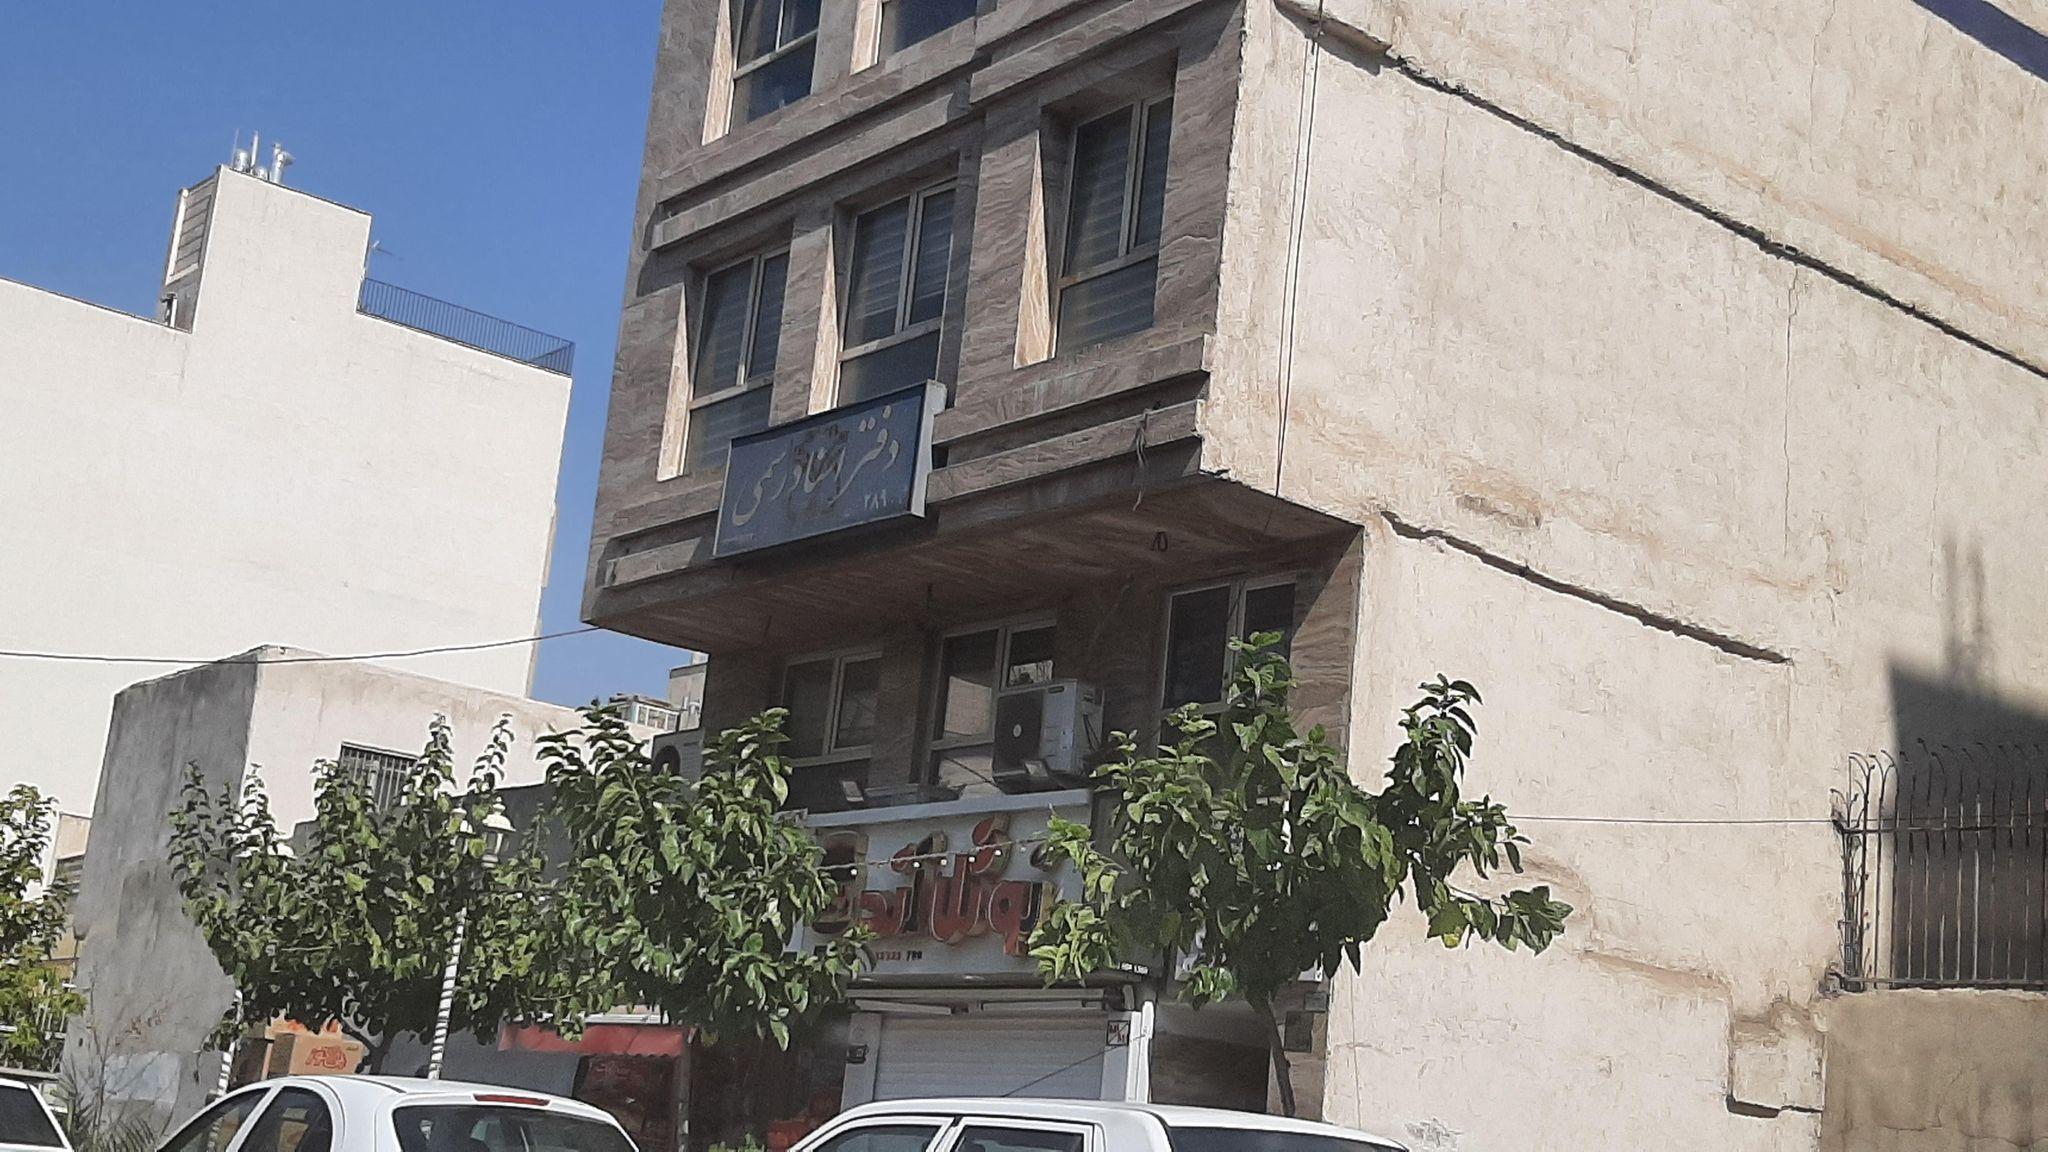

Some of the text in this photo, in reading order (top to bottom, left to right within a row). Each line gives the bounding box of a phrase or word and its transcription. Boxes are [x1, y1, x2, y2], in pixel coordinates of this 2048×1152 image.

[731, 404, 900, 526] دفتر اسناد رسمی
